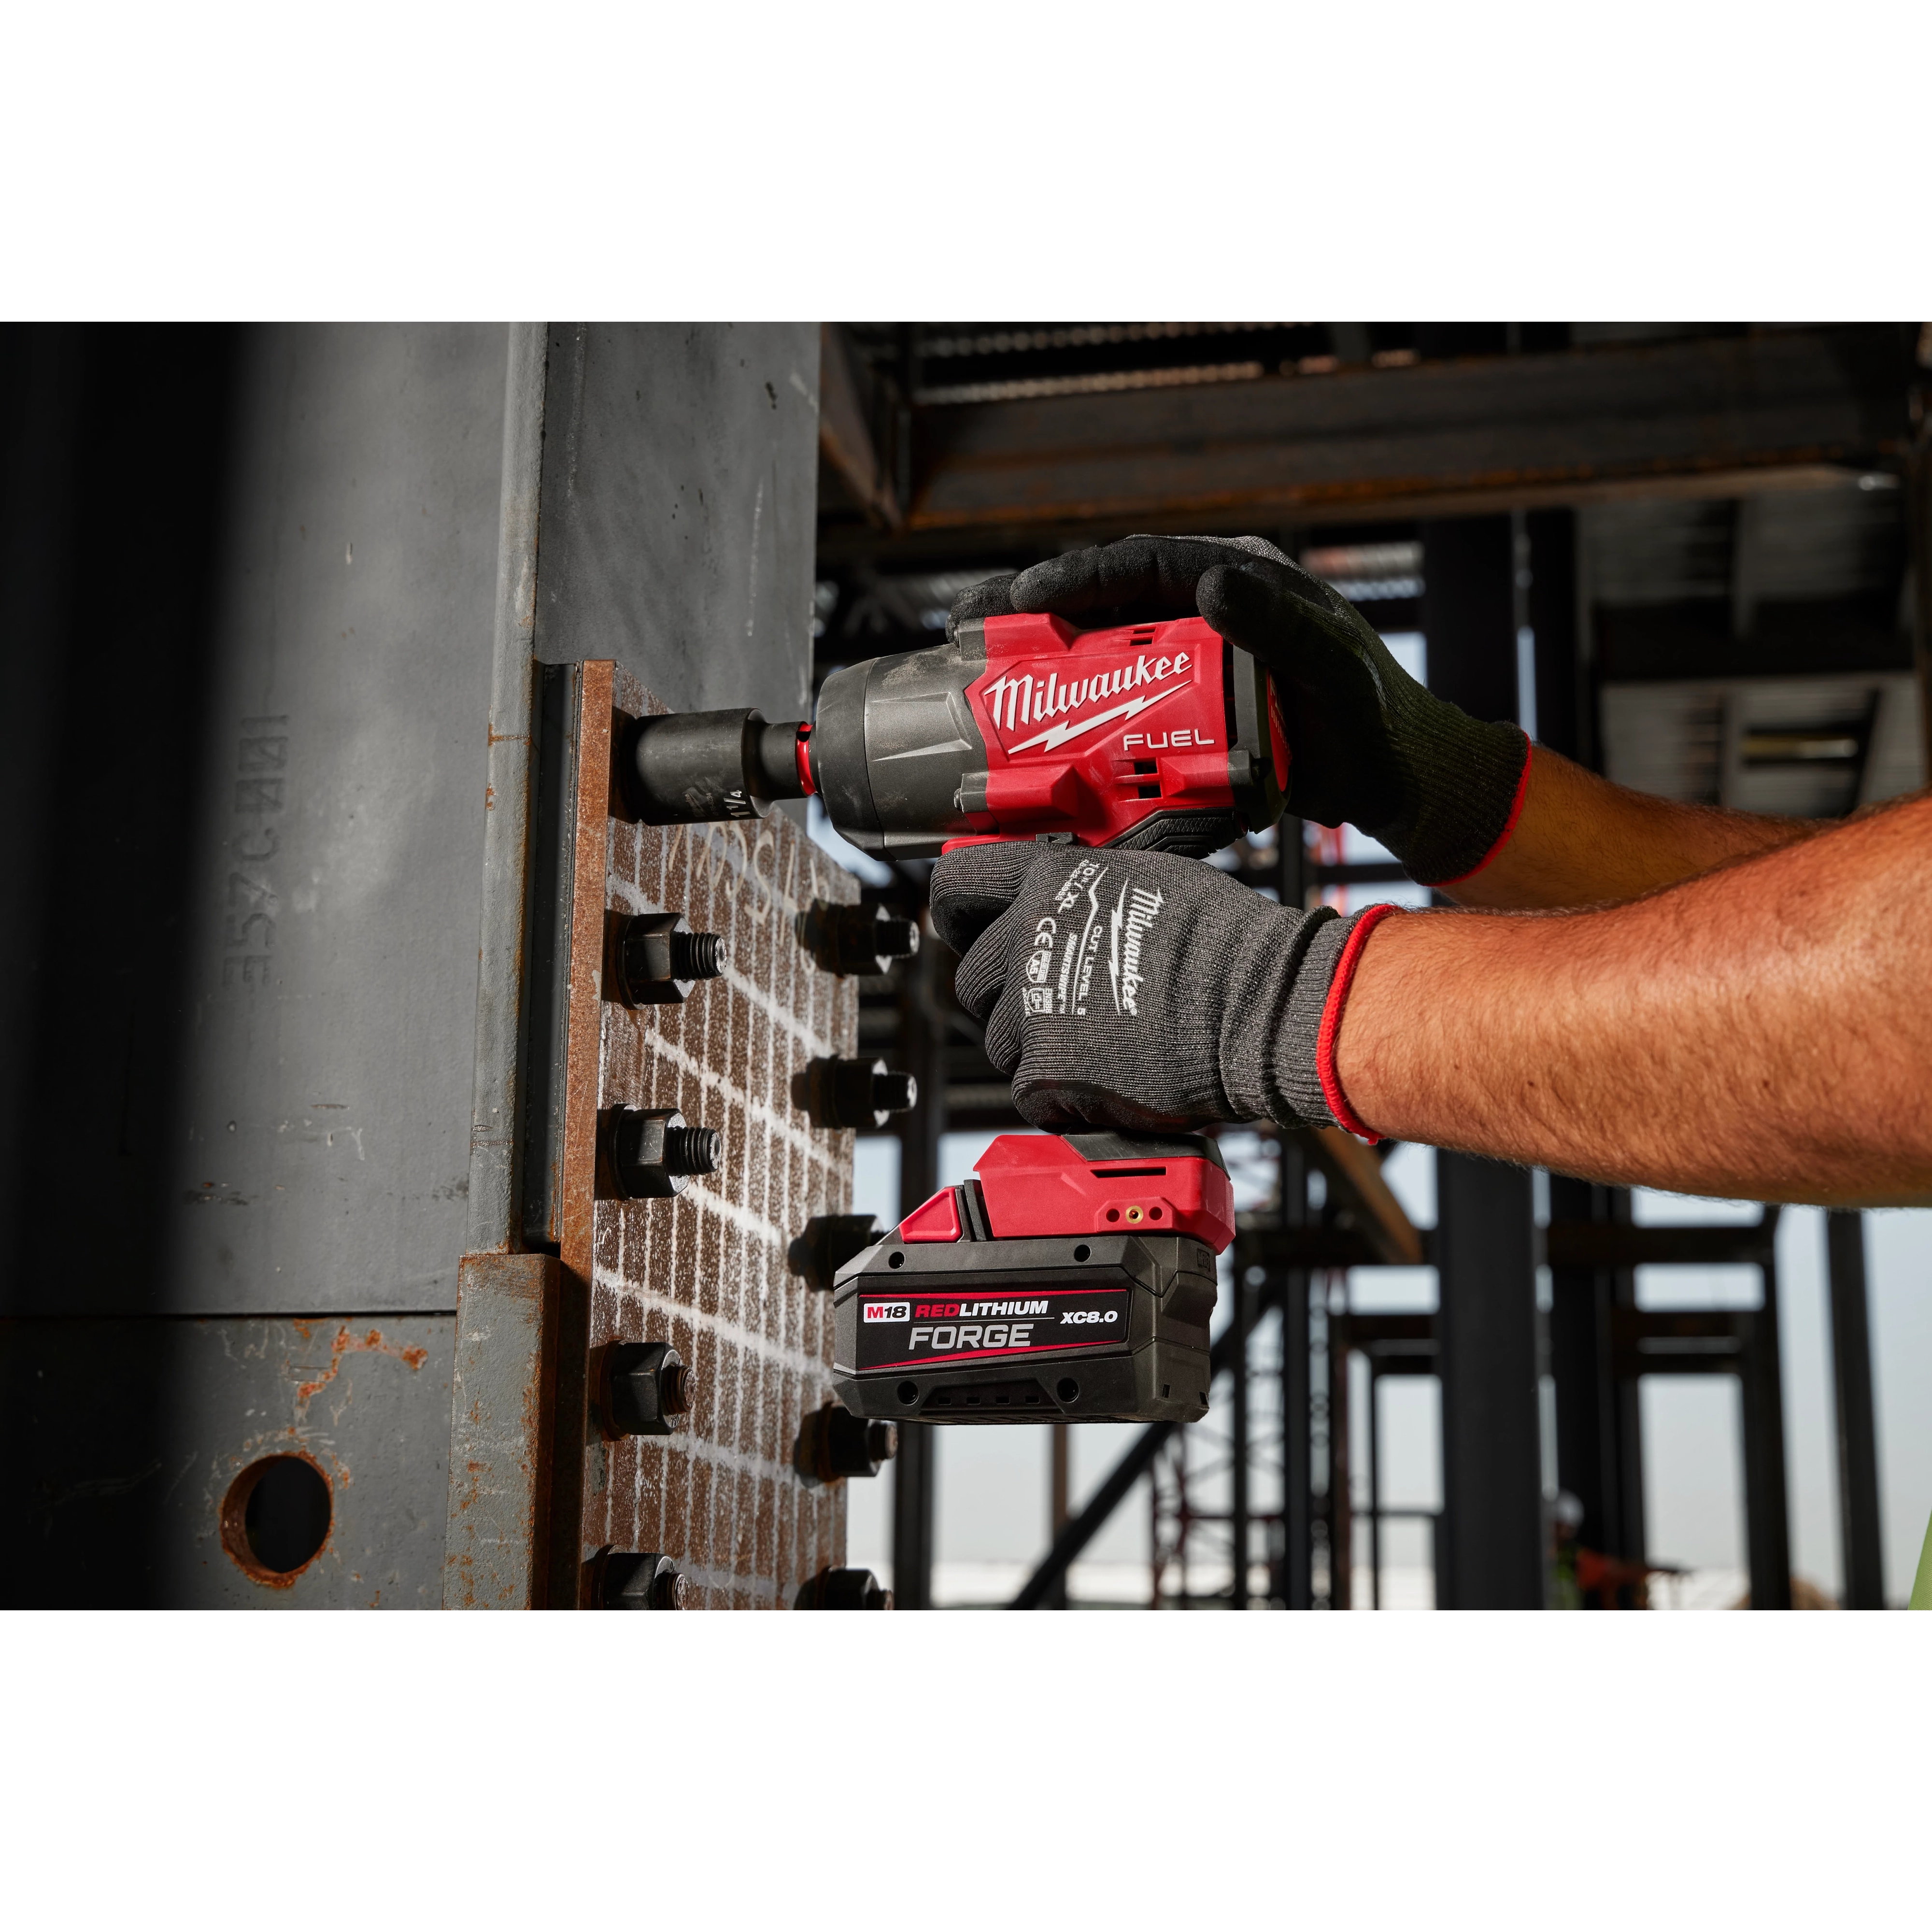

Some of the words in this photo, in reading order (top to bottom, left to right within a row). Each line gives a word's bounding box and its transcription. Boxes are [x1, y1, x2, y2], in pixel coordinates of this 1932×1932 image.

[984, 652, 1192, 732] Milwaukee
[1123, 728, 1215, 751] FUEL
[1057, 892, 1080, 913] XL
[1035, 917, 1056, 948] CE
[1089, 925, 1103, 952] CUT
[1029, 959, 1040, 974] A5
[1079, 956, 1094, 1001] LEVEL
[867, 1305, 907, 1319] M18
[915, 1300, 1049, 1318] REDLITHIUM
[1060, 1310, 1118, 1324] XC8.0
[909, 1323, 1034, 1350] FORGE
